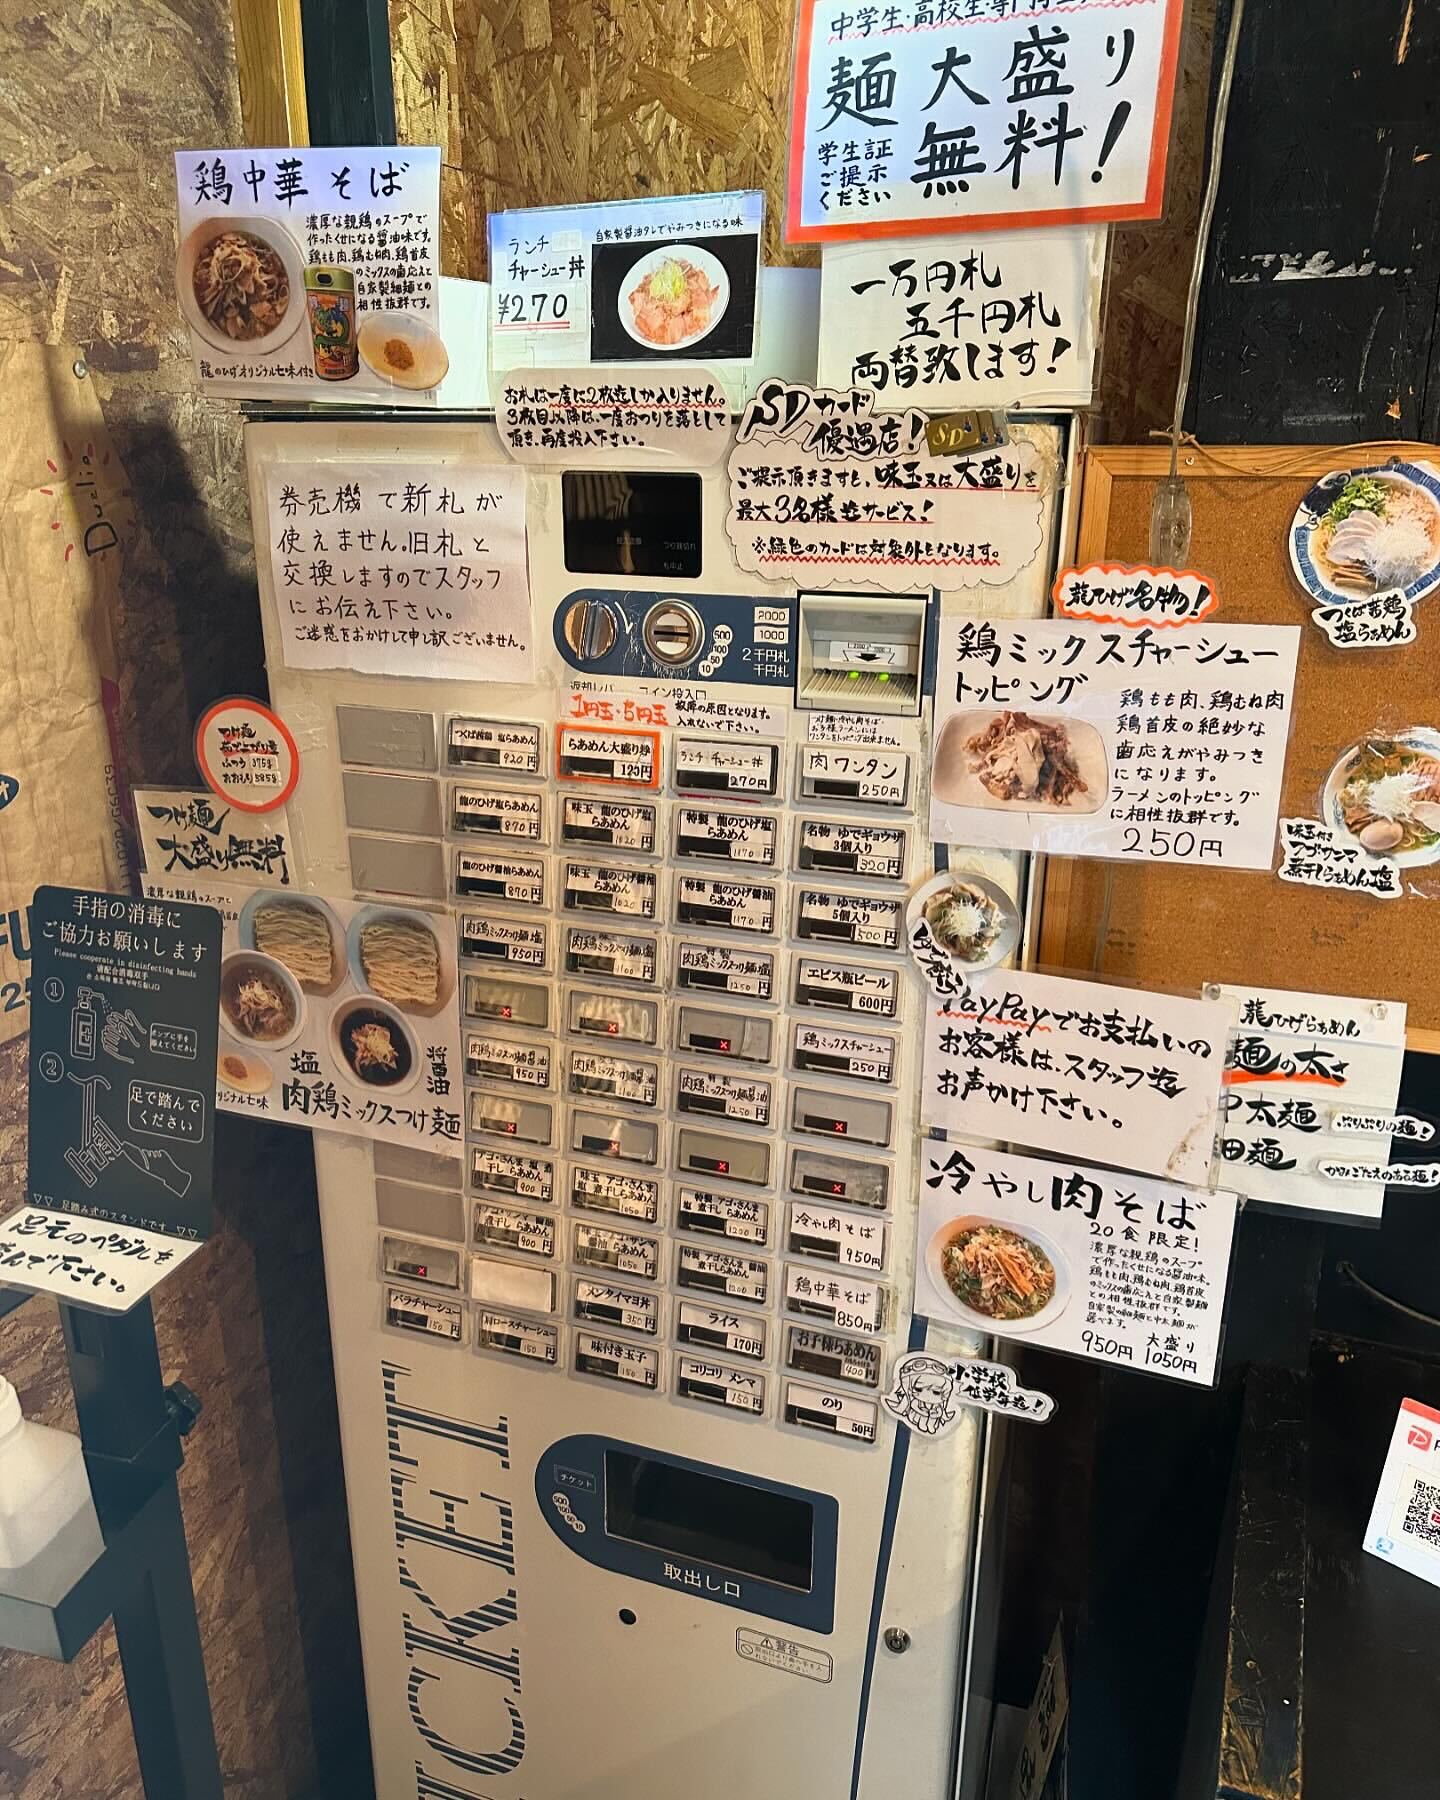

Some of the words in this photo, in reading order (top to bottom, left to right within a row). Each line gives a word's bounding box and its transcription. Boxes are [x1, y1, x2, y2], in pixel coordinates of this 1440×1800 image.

[818, 138, 894, 166] 学生証
[820, 165, 888, 188] ご提示
[820, 188, 891, 210] ください
[508, 235, 550, 255] ランチ
[508, 255, 586, 281] チャーシュー丼
[850, 249, 1000, 296] 一万円札
[498, 293, 568, 323] ¥270
[899, 290, 1061, 342] 五千円札
[280, 482, 503, 517] 券売機で新札が
[283, 560, 500, 590] 交換しますのでスタッフ
[290, 596, 452, 620] にお伝え下さい。
[758, 610, 786, 622] 2000
[715, 630, 730, 641] 500
[760, 630, 785, 641] 1000
[956, 622, 1279, 668] 鶏ミックスチャーシュー
[714, 645, 727, 654] 100
[742, 648, 790, 662] 2千円札
[702, 664, 711, 673] 10
[710, 656, 721, 665] 50
[753, 663, 790, 677] 千円札
[956, 672, 1089, 705] トッピング
[1120, 689, 1285, 712] 鶏もも肉、鶏むね肉
[1116, 715, 1266, 737] 鶏首皮の絶妙な
[1116, 741, 1265, 765] 歯応えがやみつき
[810, 752, 897, 780] 肉ワンタン
[1114, 767, 1217, 784] になります。
[730, 775, 767, 788] 270円
[861, 783, 900, 798] 250円
[1111, 787, 1261, 806] ラーメンのトッピング
[592, 816, 630, 831] らあめん
[1110, 806, 1240, 827] に相性抜群です。
[707, 826, 749, 842] らあめん
[807, 825, 830, 837] 名物
[1120, 829, 1223, 858] 250円
[594, 881, 631, 894] らあめん
[709, 894, 747, 909] らあめん
[806, 893, 829, 907] 名物
[72, 896, 181, 928] 手指の消毒に
[43, 920, 207, 962] ご協力お願いします
[859, 996, 894, 1012] 600円
[290, 1050, 322, 1075] 塩
[130, 1086, 200, 1112] 足で踏んで
[282, 1077, 462, 1140] 肉鶏ミックスつけ麺
[140, 1110, 193, 1132] ください
[509, 1167, 543, 1182] らあめん
[926, 1150, 1207, 1231] 冷やし肉そば
[727, 1209, 758, 1221] らあめん
[795, 1213, 874, 1238] 冷やし肉そば
[516, 1220, 550, 1237] らあめん
[613, 1242, 648, 1258] らあめん
[846, 1248, 880, 1267] 950円
[795, 1276, 871, 1304] 鶏中華そば
[708, 1312, 739, 1328] ライス
[836, 1310, 873, 1332] 850円
[733, 1337, 762, 1355] 170円
[1081, 1330, 1133, 1360] 950円
[1146, 1332, 1194, 1353] 大盛り
[1145, 1348, 1197, 1373] 1050円
[730, 1372, 756, 1387] メンマ
[822, 1397, 843, 1411] のり
[851, 1423, 874, 1437] 50円
[663, 1562, 740, 1598] 取出し口
